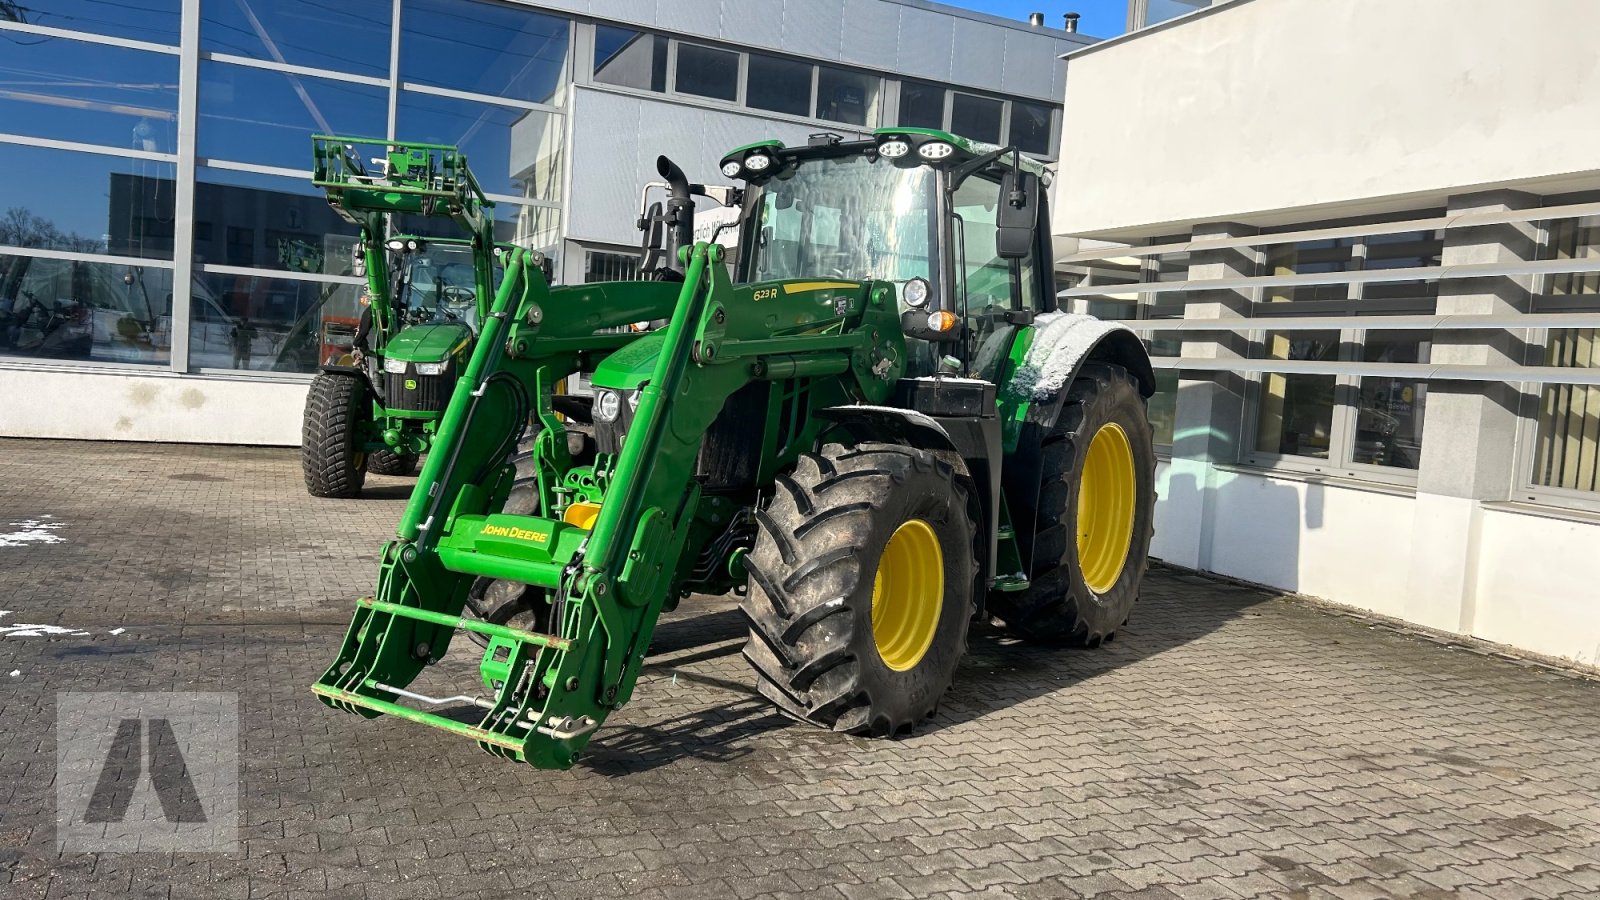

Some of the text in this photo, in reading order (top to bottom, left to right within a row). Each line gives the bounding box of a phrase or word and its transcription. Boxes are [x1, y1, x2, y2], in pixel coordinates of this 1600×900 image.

[753, 290, 769, 301] 623
[480, 524, 548, 542] JOHN DEERE
